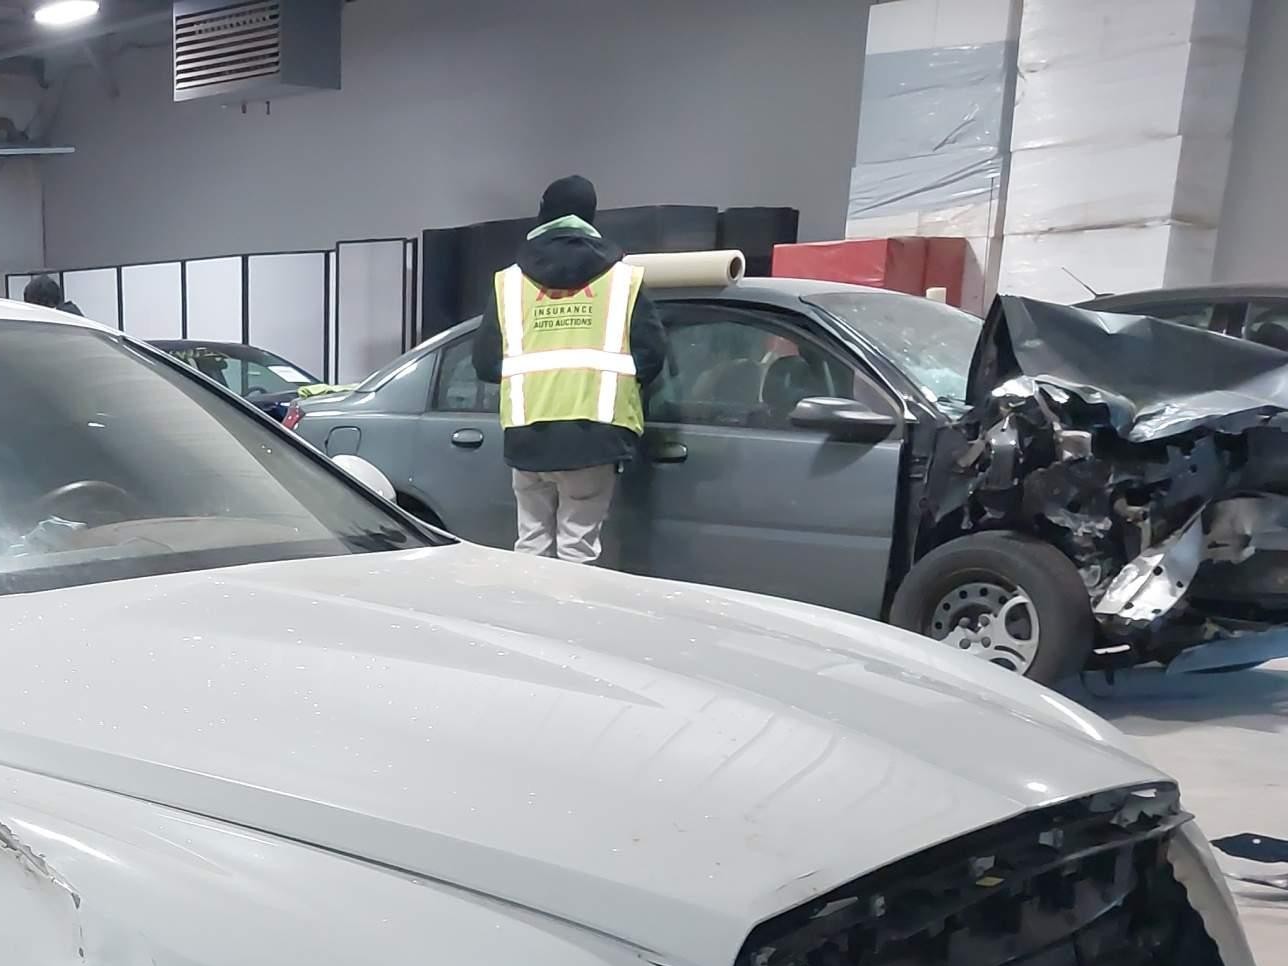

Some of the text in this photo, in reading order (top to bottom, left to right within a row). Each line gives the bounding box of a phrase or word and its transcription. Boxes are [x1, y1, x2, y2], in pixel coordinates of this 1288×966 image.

[534, 306, 593, 317] INSURANCE
[533, 318, 592, 329] AUTO AUCTIONS
